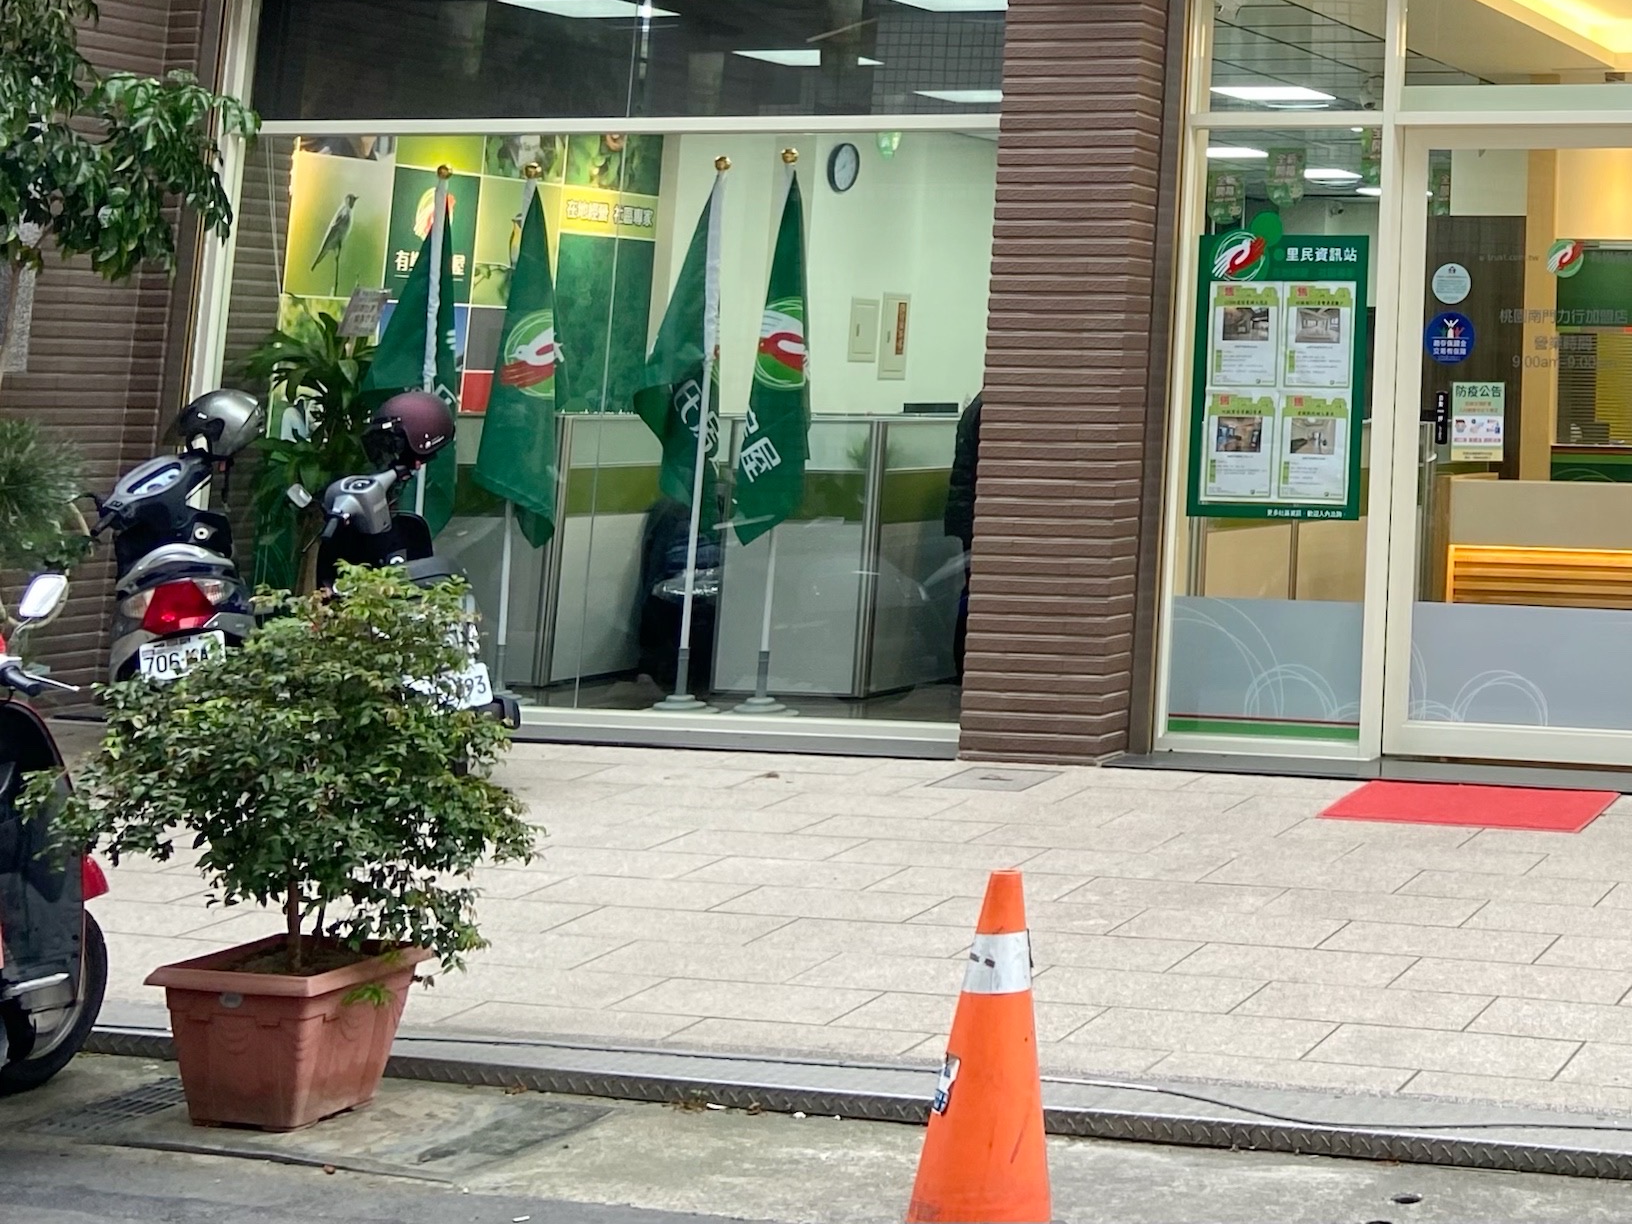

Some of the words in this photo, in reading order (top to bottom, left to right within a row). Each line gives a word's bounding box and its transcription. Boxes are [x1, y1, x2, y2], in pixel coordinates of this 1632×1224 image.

[566, 199, 609, 223] 在地經營
[612, 203, 654, 227] 社區專家
[1285, 247, 1358, 262] 里民資訊站
[1499, 309, 1628, 324] 桃園南門力行加盟店
[1455, 385, 1501, 398] 防疫公告
